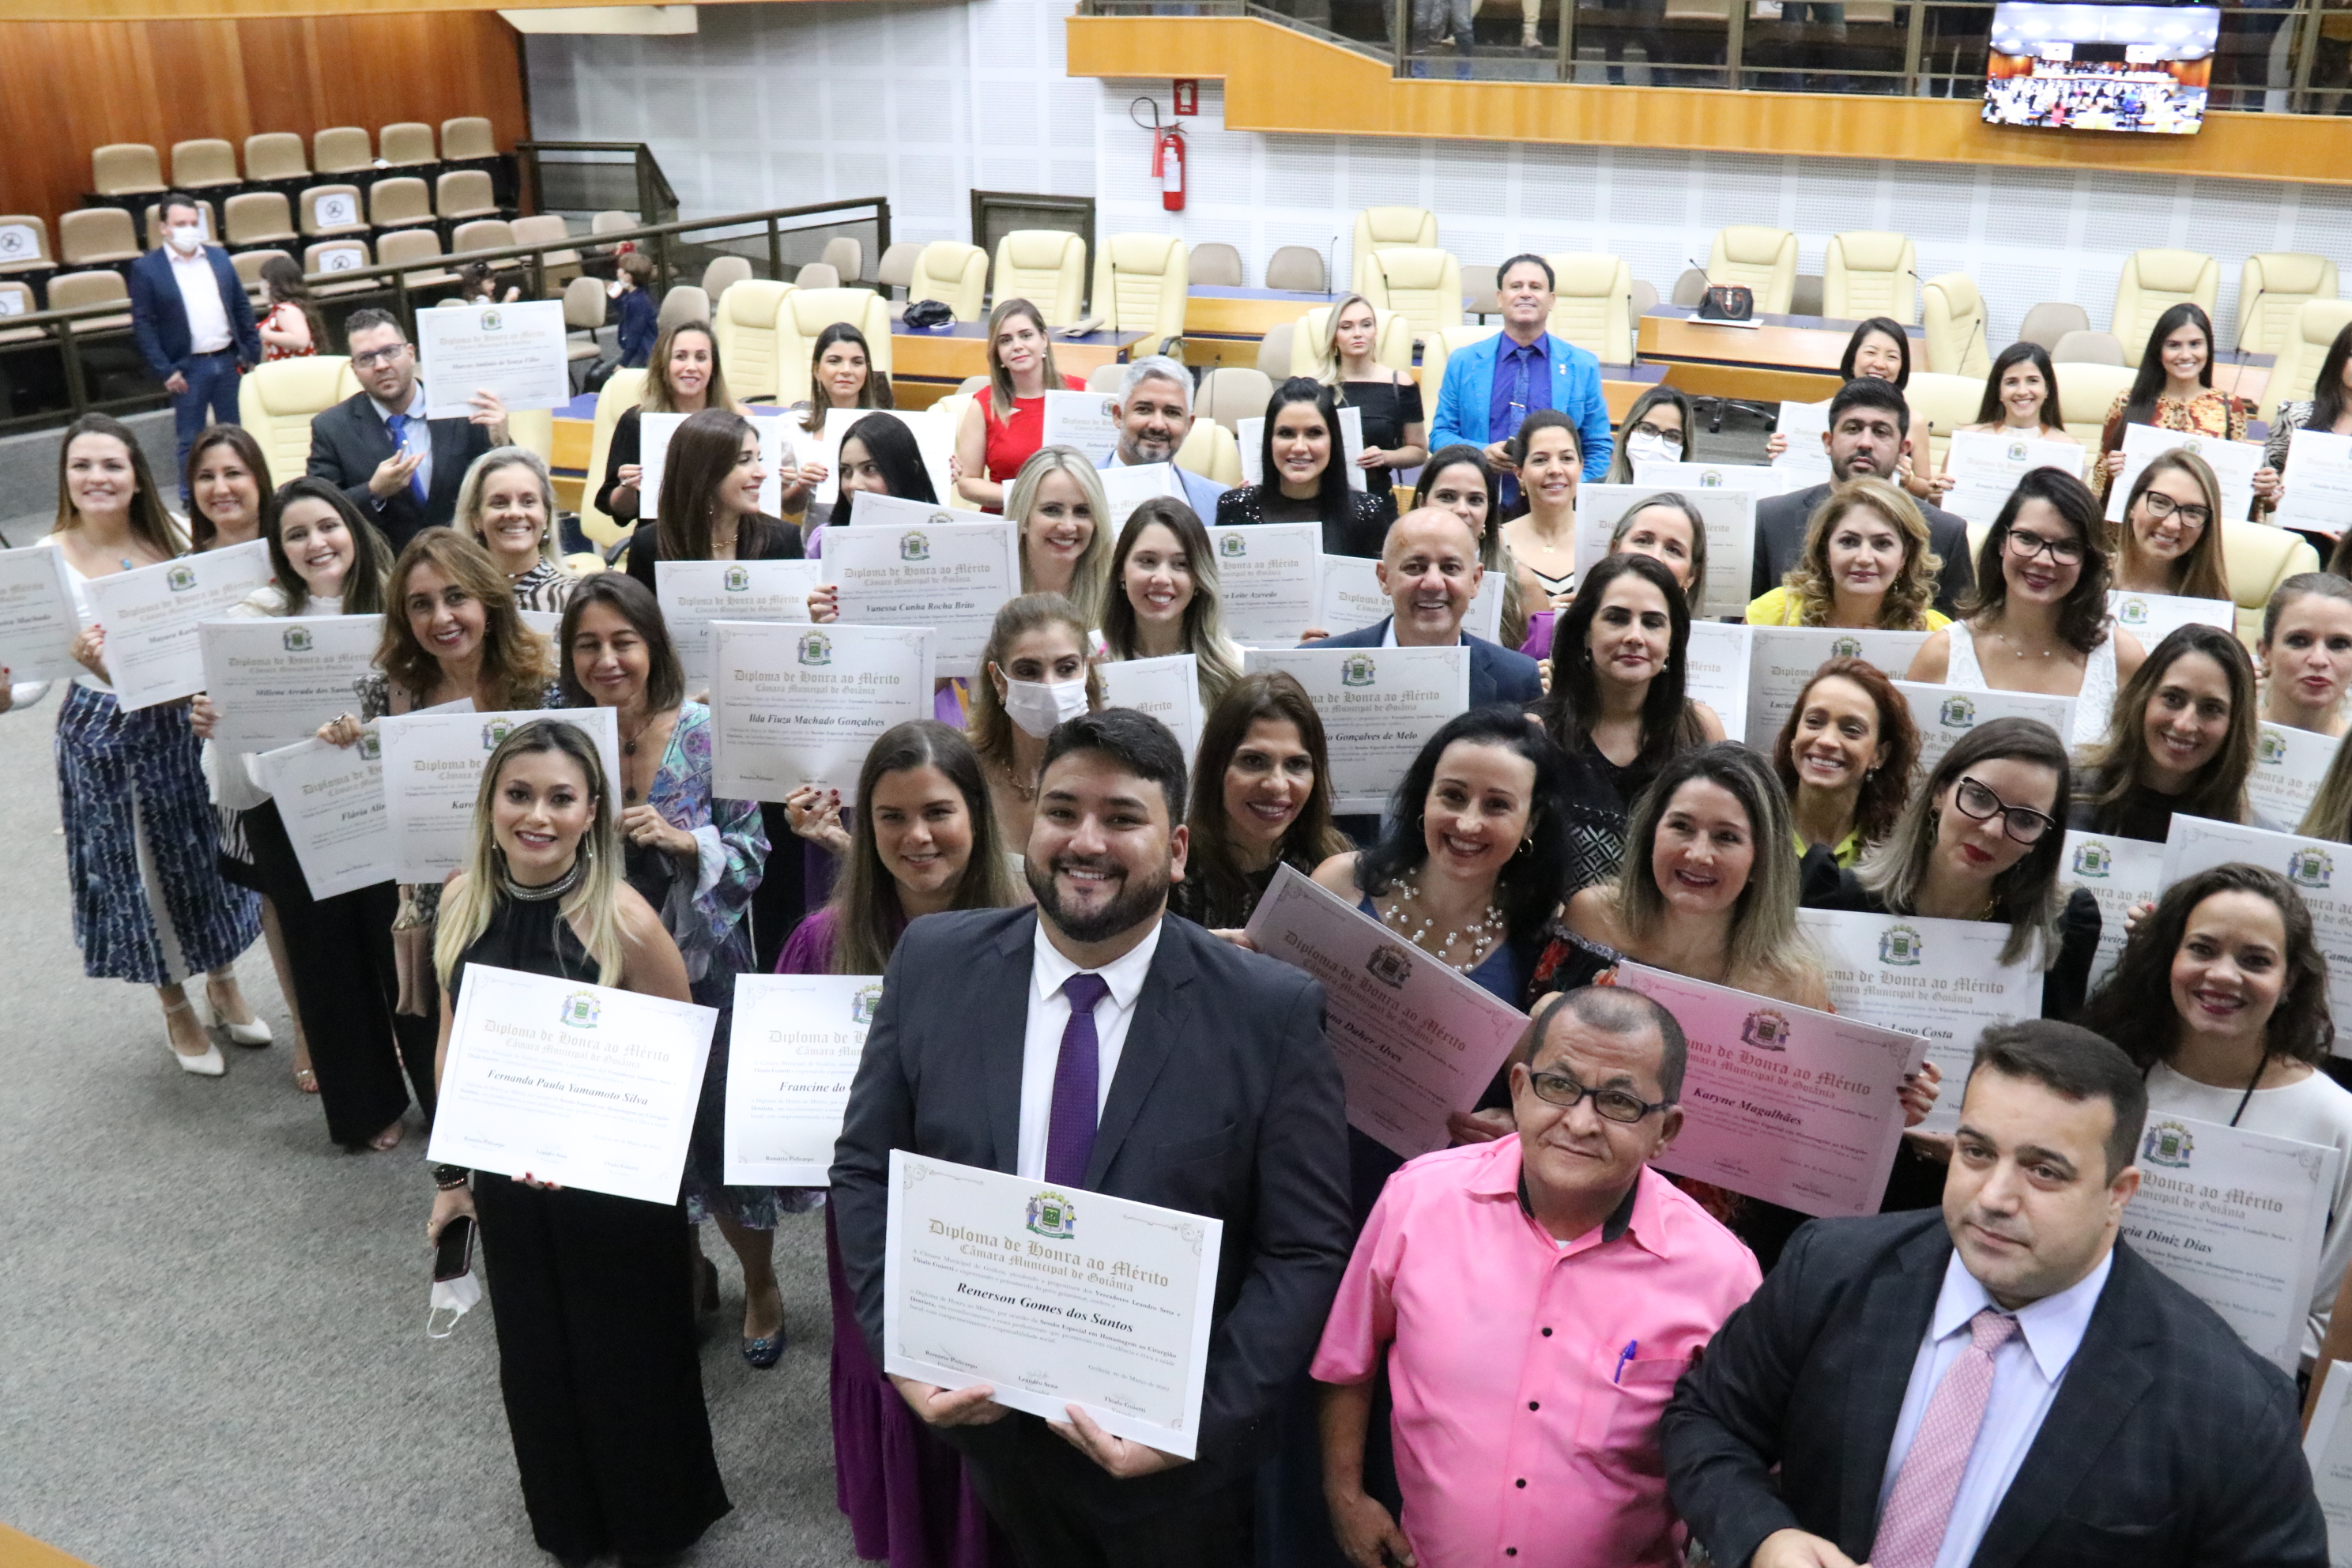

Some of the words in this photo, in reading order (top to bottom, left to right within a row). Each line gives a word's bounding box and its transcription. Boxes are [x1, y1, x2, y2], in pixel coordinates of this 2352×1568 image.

[844, 567, 886, 579] Diploma
[889, 567, 899, 576] de
[903, 565, 937, 575] Honra
[954, 564, 990, 575] Mérito
[1222, 560, 1252, 570] Honra
[1267, 559, 1298, 569] Mérito
[677, 597, 712, 606] Diploma
[726, 596, 754, 605] Honra
[769, 594, 799, 605] Mérito
[1339, 591, 1378, 604] Diploma
[1381, 594, 1393, 605] de
[1689, 661, 1721, 673] Mérito
[733, 669, 780, 682] Diploma
[783, 671, 795, 682] de
[800, 670, 836, 683] Honra
[840, 675, 854, 684] ao
[858, 672, 899, 684] Mérito
[755, 684, 785, 692] Câmara
[787, 684, 827, 694] Municipal
[842, 685, 875, 695] Goiânia
[1327, 693, 1340, 703] de
[1344, 692, 1380, 703] Honra
[1384, 693, 1396, 702] ao
[1400, 689, 1440, 703] Mérito
[1133, 702, 1172, 713] Mérito
[749, 714, 765, 722] Ilda
[767, 714, 791, 724] Fiuza
[795, 715, 835, 725] Machado
[837, 717, 884, 727] Gonçalves
[1336, 732, 1380, 741] Gonçalves
[413, 760, 465, 771] Diploma
[469, 759, 481, 768] de
[301, 775, 349, 795] Diploma
[352, 771, 363, 780] de
[438, 771, 472, 780] Câmara
[451, 801, 474, 809] Karo
[2118, 890, 2132, 901] ao
[2099, 933, 2128, 945] iveira
[2323, 948, 2352, 963] Cama
[1859, 970, 1874, 982] de
[1880, 971, 1926, 987] Honra
[1931, 978, 1947, 989] ao
[1953, 977, 2003, 994] Mérito
[1284, 929, 1338, 971] Diploma
[1340, 966, 1355, 982] de
[1359, 976, 1400, 1011] Honra
[1401, 1008, 1418, 1021] ao
[1419, 1019, 1466, 1051] Mérito
[1863, 986, 1914, 999] Municipal
[1917, 990, 1928, 1000] de
[1932, 991, 1973, 1004] Goiânia
[768, 1030, 828, 1045] Diploma
[834, 1031, 848, 1043] de
[1922, 1026, 1954, 1039] Costa
[484, 1019, 536, 1038] Diploma
[540, 1029, 554, 1042] de
[559, 1031, 600, 1050] Honra
[604, 1042, 619, 1053] ao
[622, 1043, 669, 1062] Mérito
[1344, 1022, 1375, 1044] Daher
[1375, 1044, 1402, 1063] Alves
[505, 1038, 540, 1051] Câmara
[541, 1044, 588, 1060] Municipal
[590, 1053, 601, 1061] de
[603, 1054, 640, 1069] Goiânia
[795, 1046, 835, 1056] Câmara
[1717, 1045, 1733, 1059] de
[1740, 1050, 1788, 1074] Honra
[1792, 1069, 1811, 1080] ao
[1815, 1072, 1871, 1095] Mérito
[487, 1069, 533, 1085] Fernanda
[536, 1077, 565, 1091] Paula
[568, 1083, 620, 1099] Yamamoto
[621, 1093, 648, 1105] Silva
[779, 1081, 829, 1092] Francine
[831, 1083, 846, 1092] do
[1693, 1087, 1736, 1106] Karyne
[1741, 1100, 1801, 1125] Magalhães
[2143, 1170, 2194, 1194] Honra
[2199, 1186, 2218, 1199] ao
[2222, 1189, 2282, 1212] Mérito
[2146, 1230, 2179, 1247] Diniz
[2183, 1238, 2211, 1253] Dias
[929, 1218, 997, 1247] Diploma
[1004, 1236, 1021, 1252] de
[1027, 1240, 1080, 1265] Honra
[1086, 1257, 1104, 1271] ao
[1110, 1261, 1168, 1287] Mérito
[959, 1243, 1004, 1262] Câmara
[1008, 1255, 1067, 1276] Municipal
[1071, 1268, 1084, 1280] de
[1087, 1272, 1133, 1292] Goiânia
[957, 1282, 1016, 1305] Renerson
[1020, 1297, 1061, 1314] Gomes
[1066, 1307, 1087, 1321] dos
[1090, 1313, 1133, 1332] Santos
